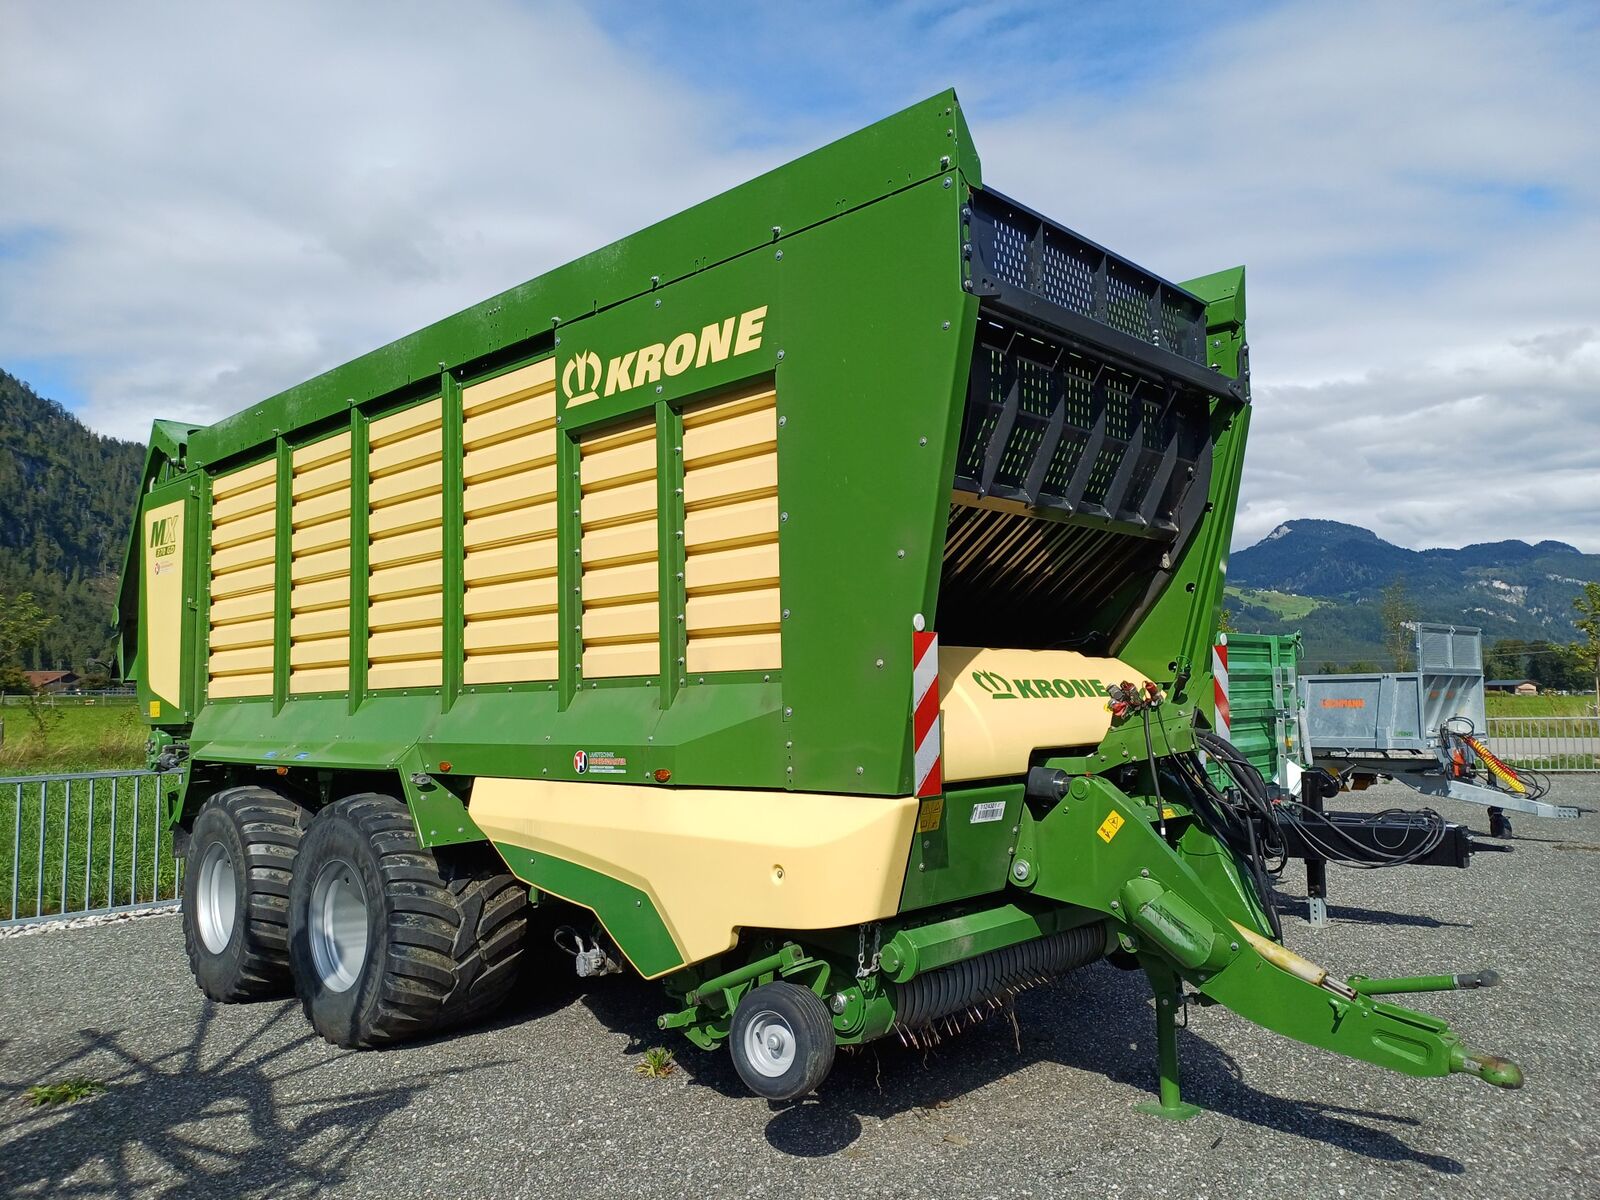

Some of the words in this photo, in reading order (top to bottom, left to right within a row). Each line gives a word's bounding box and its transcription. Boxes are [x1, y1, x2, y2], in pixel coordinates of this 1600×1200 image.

[603, 304, 769, 398] KRONE
[150, 514, 179, 548] MX
[1012, 678, 1111, 699] KRONE
